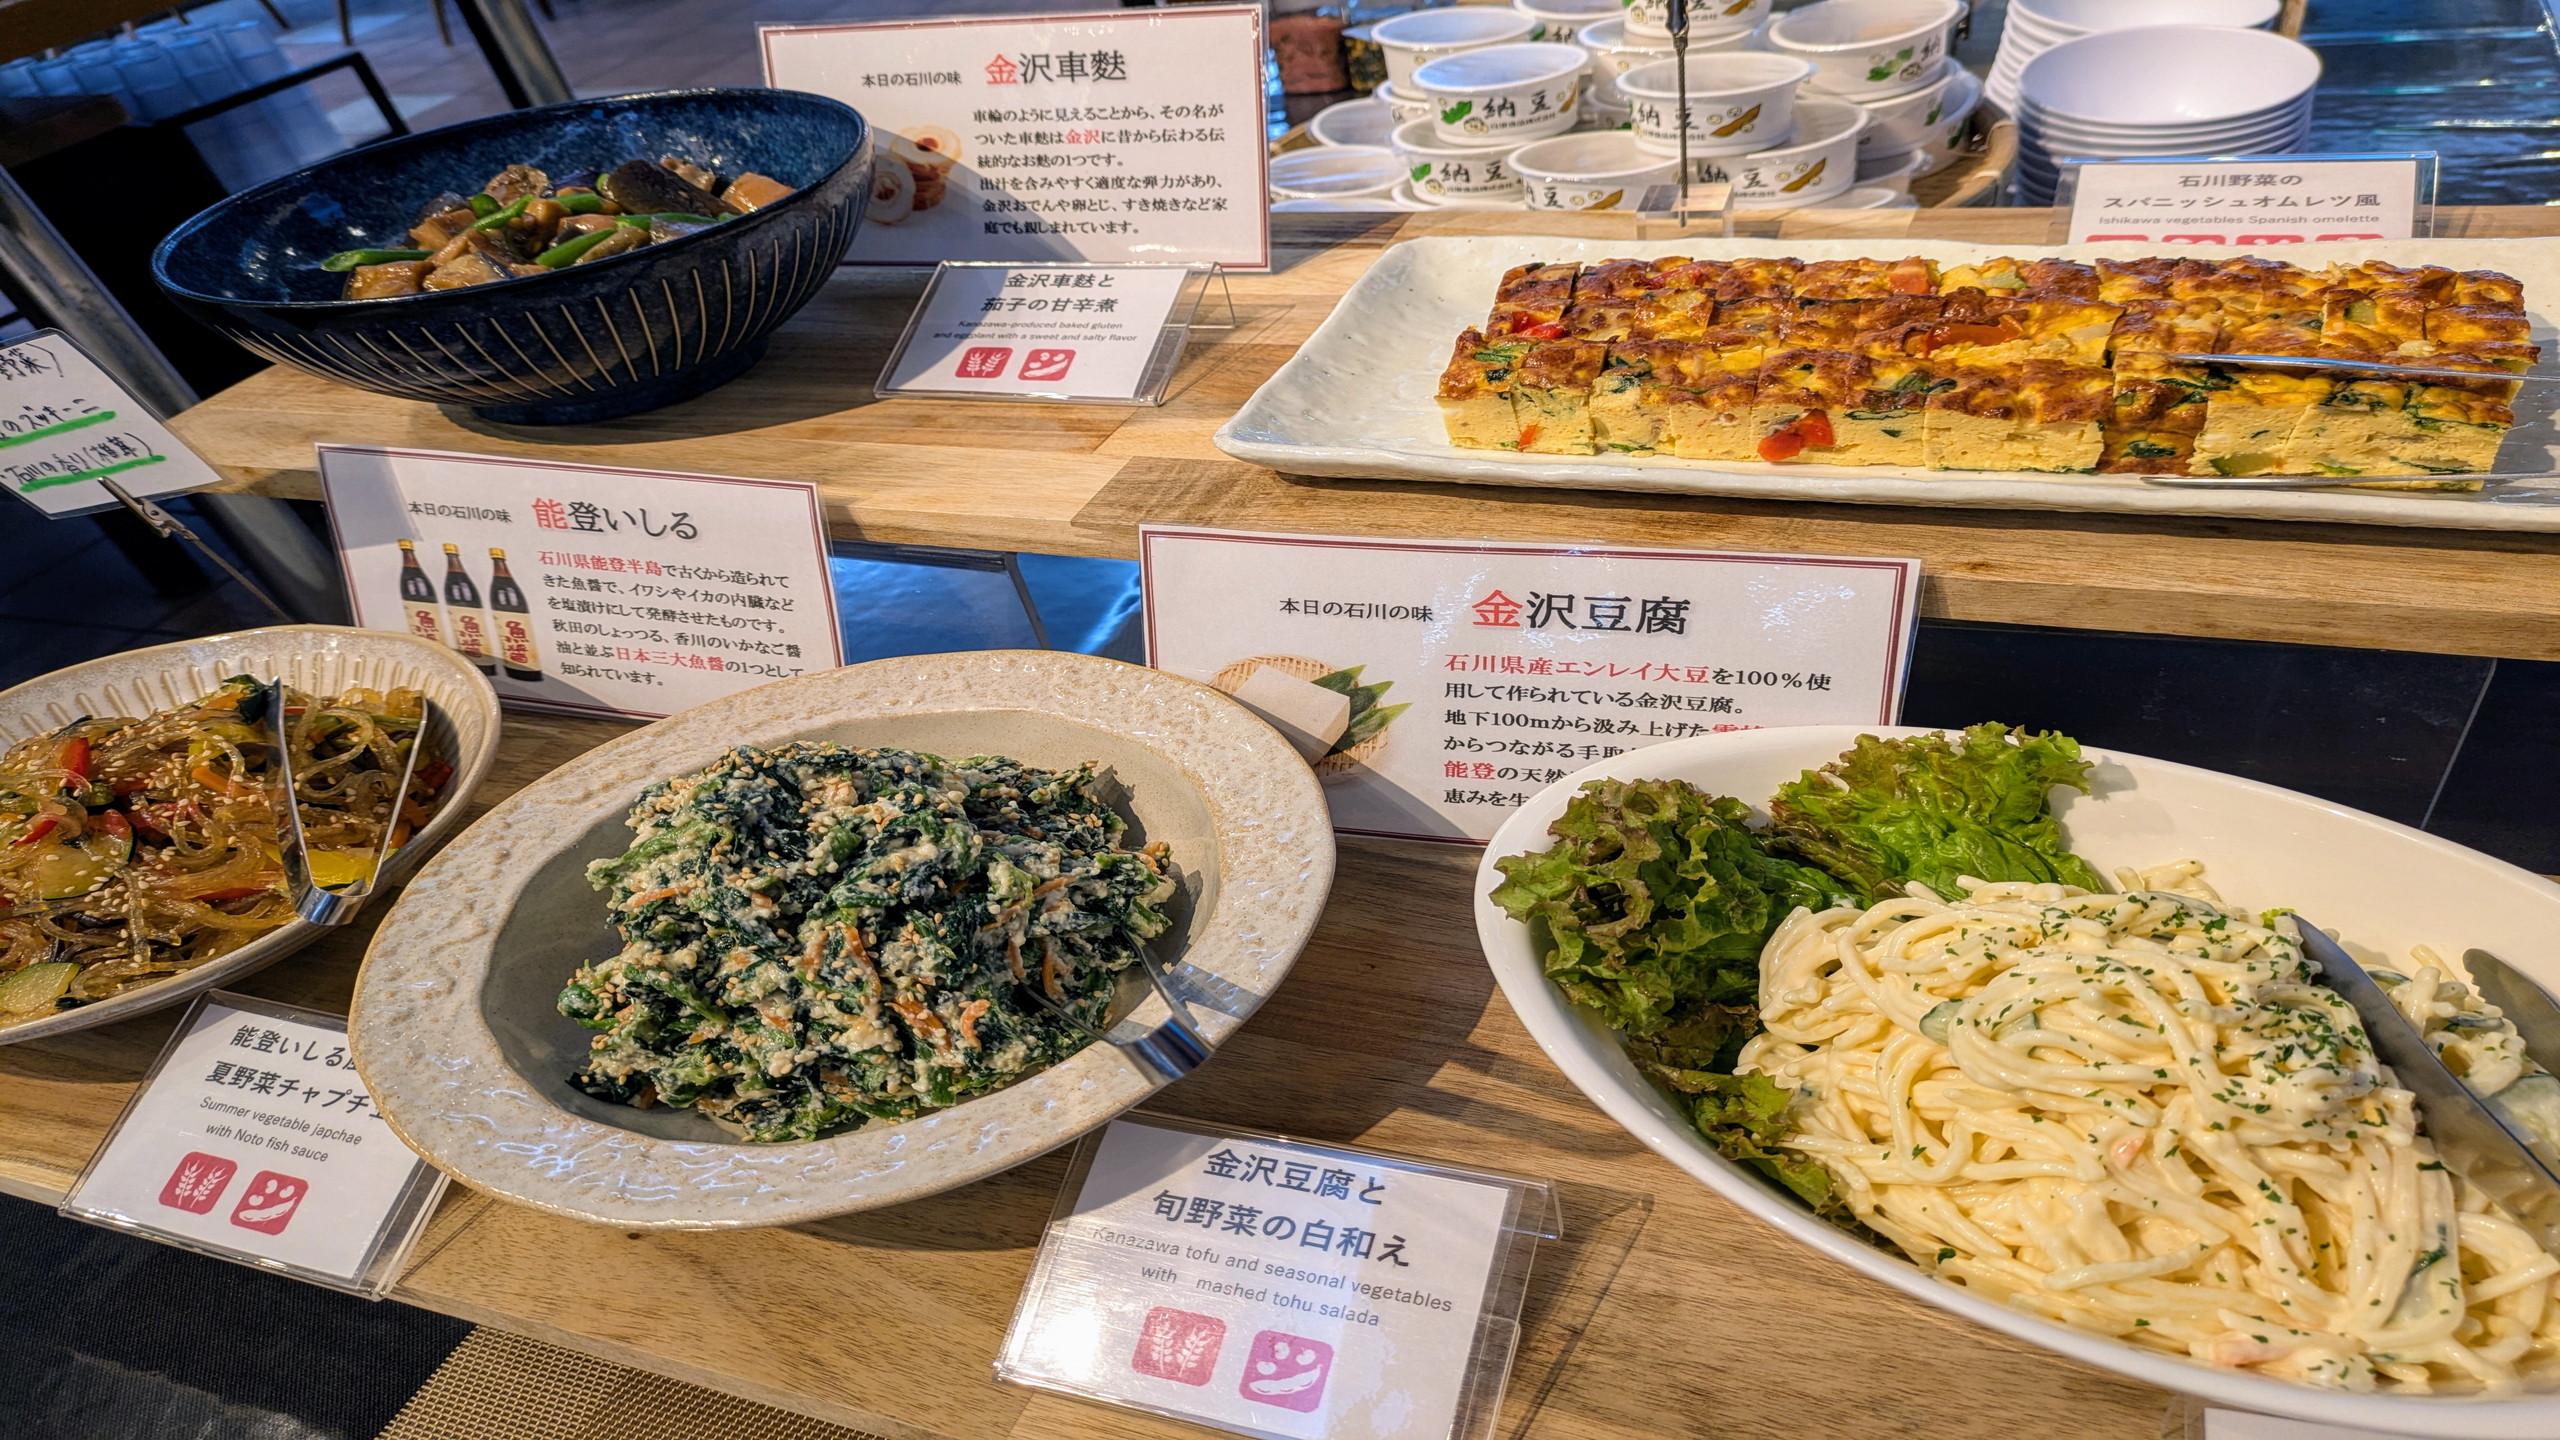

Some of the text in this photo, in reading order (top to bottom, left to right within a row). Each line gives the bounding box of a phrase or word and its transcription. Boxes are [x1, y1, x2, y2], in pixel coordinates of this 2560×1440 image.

[861, 50, 1127, 88] 本日の石川の味 金沢車麩
[973, 104, 1224, 123] 車輪のように見えることから、その名が
[1482, 89, 1551, 119] 納豆
[979, 174, 1223, 191] 出汁を含みやすく適度な弾力があり、
[1440, 160, 1507, 183] 納豆
[2178, 173, 2303, 188] 石川野菜の
[982, 196, 1227, 213] 金沢おでんや卵とじ、すき焼きなど家
[2103, 193, 2381, 209] スパニッシュオムレツ風
[984, 219, 1140, 235] 庭でも親しまれています。
[2099, 214, 2379, 226] Ishikawa vegetables Spanish omelette
[981, 297, 1119, 313] 茄子の甘辛煮
[933, 331, 952, 339] and
[954, 331, 996, 342] eggplant
[997, 332, 1019, 340] with
[1029, 333, 1060, 341] sweet
[1062, 333, 1081, 341] and
[1083, 333, 1108, 343] salty
[1109, 333, 1138, 342] flavor
[958, 320, 1123, 331] Kanazawa-produced baked gluten
[409, 497, 699, 541] 本日の石川の味 能登いしる
[538, 551, 790, 589] 石川県能登半島で古くから造られて
[543, 574, 794, 613] きた魚醤で、イワシやイカの内臓など
[548, 596, 785, 634] を塩漬けにして発酵させたものです。
[1280, 589, 1691, 637] 本日の石川の味 金沢豆腐
[552, 618, 802, 659] 秋田のしょっつる、香川のいかなご醤
[561, 662, 664, 687] 知られています。
[1444, 653, 1832, 691] 石川県産エンレイ大豆を100%使
[1444, 682, 1744, 715] 用して作られている金沢豆腐。
[1443, 736, 1637, 762] からつながる手取
[1443, 760, 1574, 785] 能登の天然
[200, 1096, 362, 1147] Summer vegetable japchae
[205, 1122, 329, 1163] with Noto fish sauce
[1203, 1149, 1386, 1206] 金沢豆腐と
[1152, 1189, 1410, 1268] 旬野菜の白和え
[1093, 1226, 1453, 1314] Kanazawa tofu and seasonal vegetables
[1141, 1265, 1380, 1328] with mashed tohu salada
